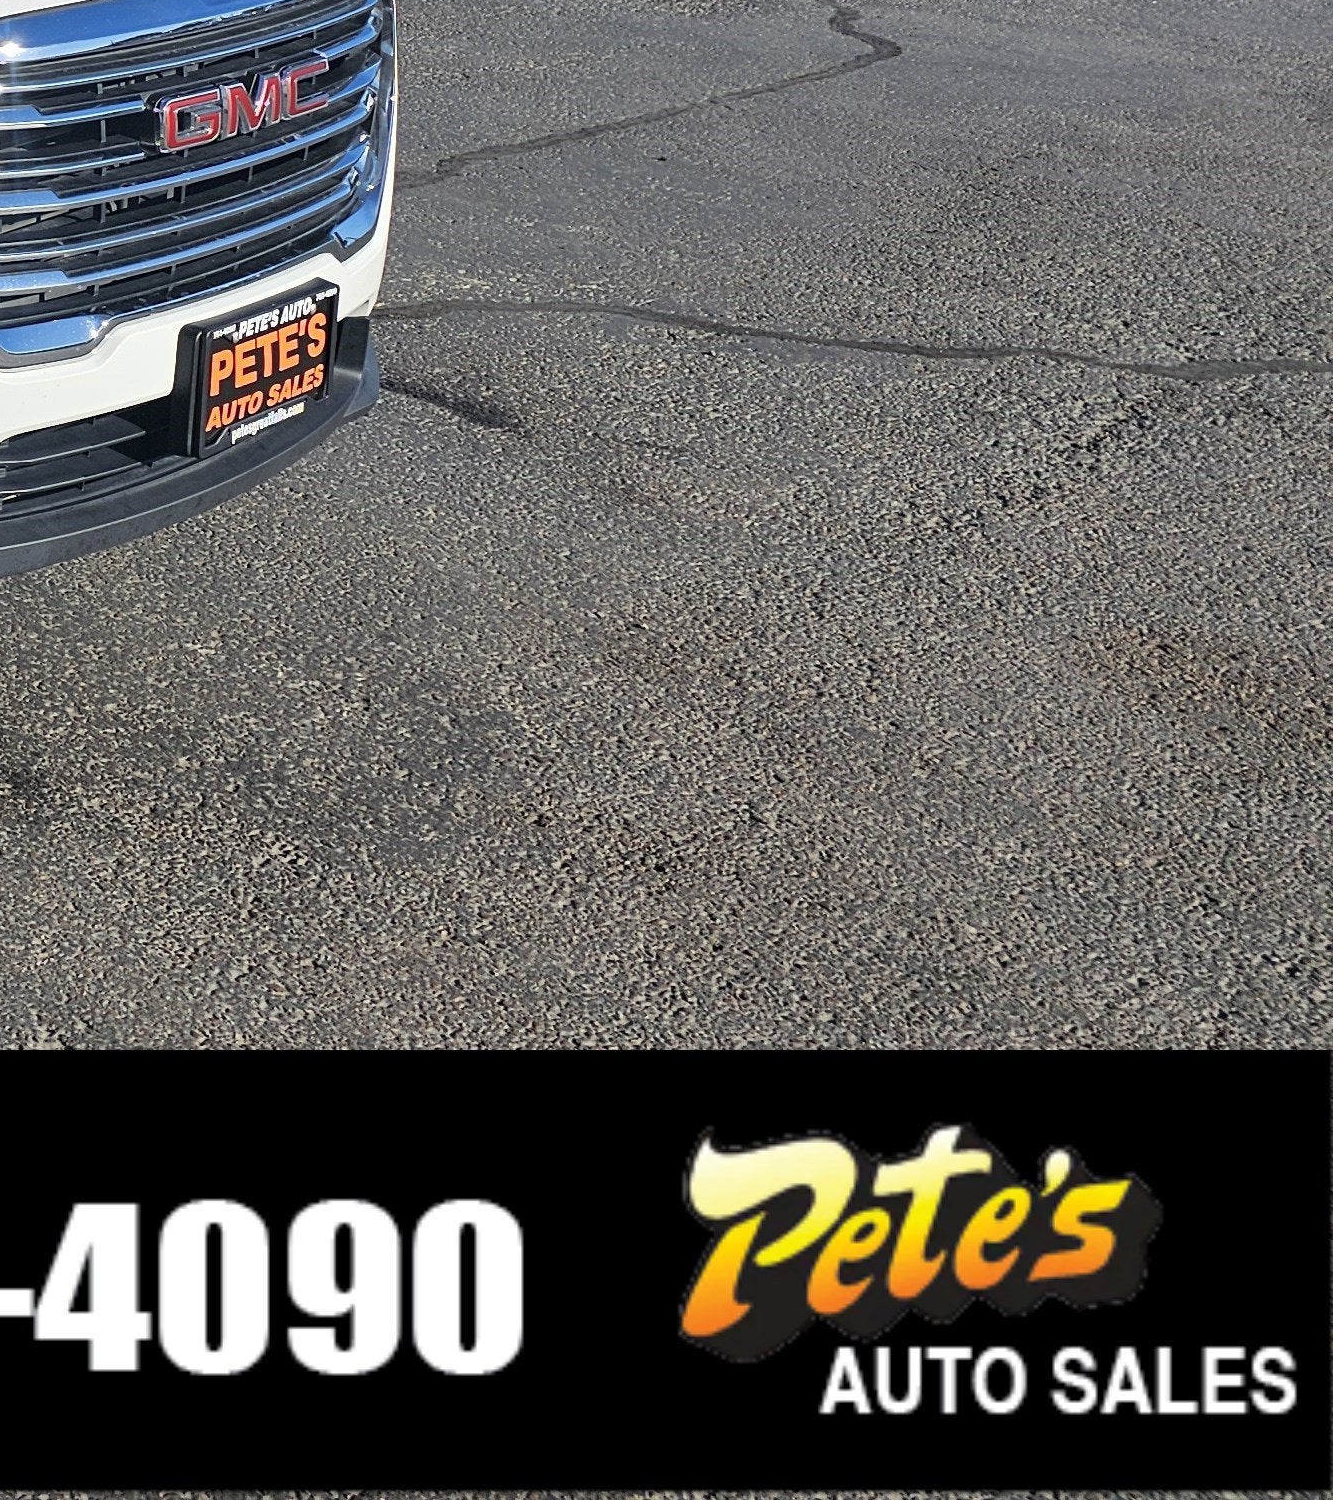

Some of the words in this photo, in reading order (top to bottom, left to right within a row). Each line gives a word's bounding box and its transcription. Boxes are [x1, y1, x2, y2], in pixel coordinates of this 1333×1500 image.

[154, 57, 330, 153] GMC
[209, 312, 327, 397] PETE'S
[238, 308, 280, 340] PETE'S
[281, 297, 312, 325] AUTO
[205, 390, 264, 432] AUTO
[266, 363, 325, 407] SALES
